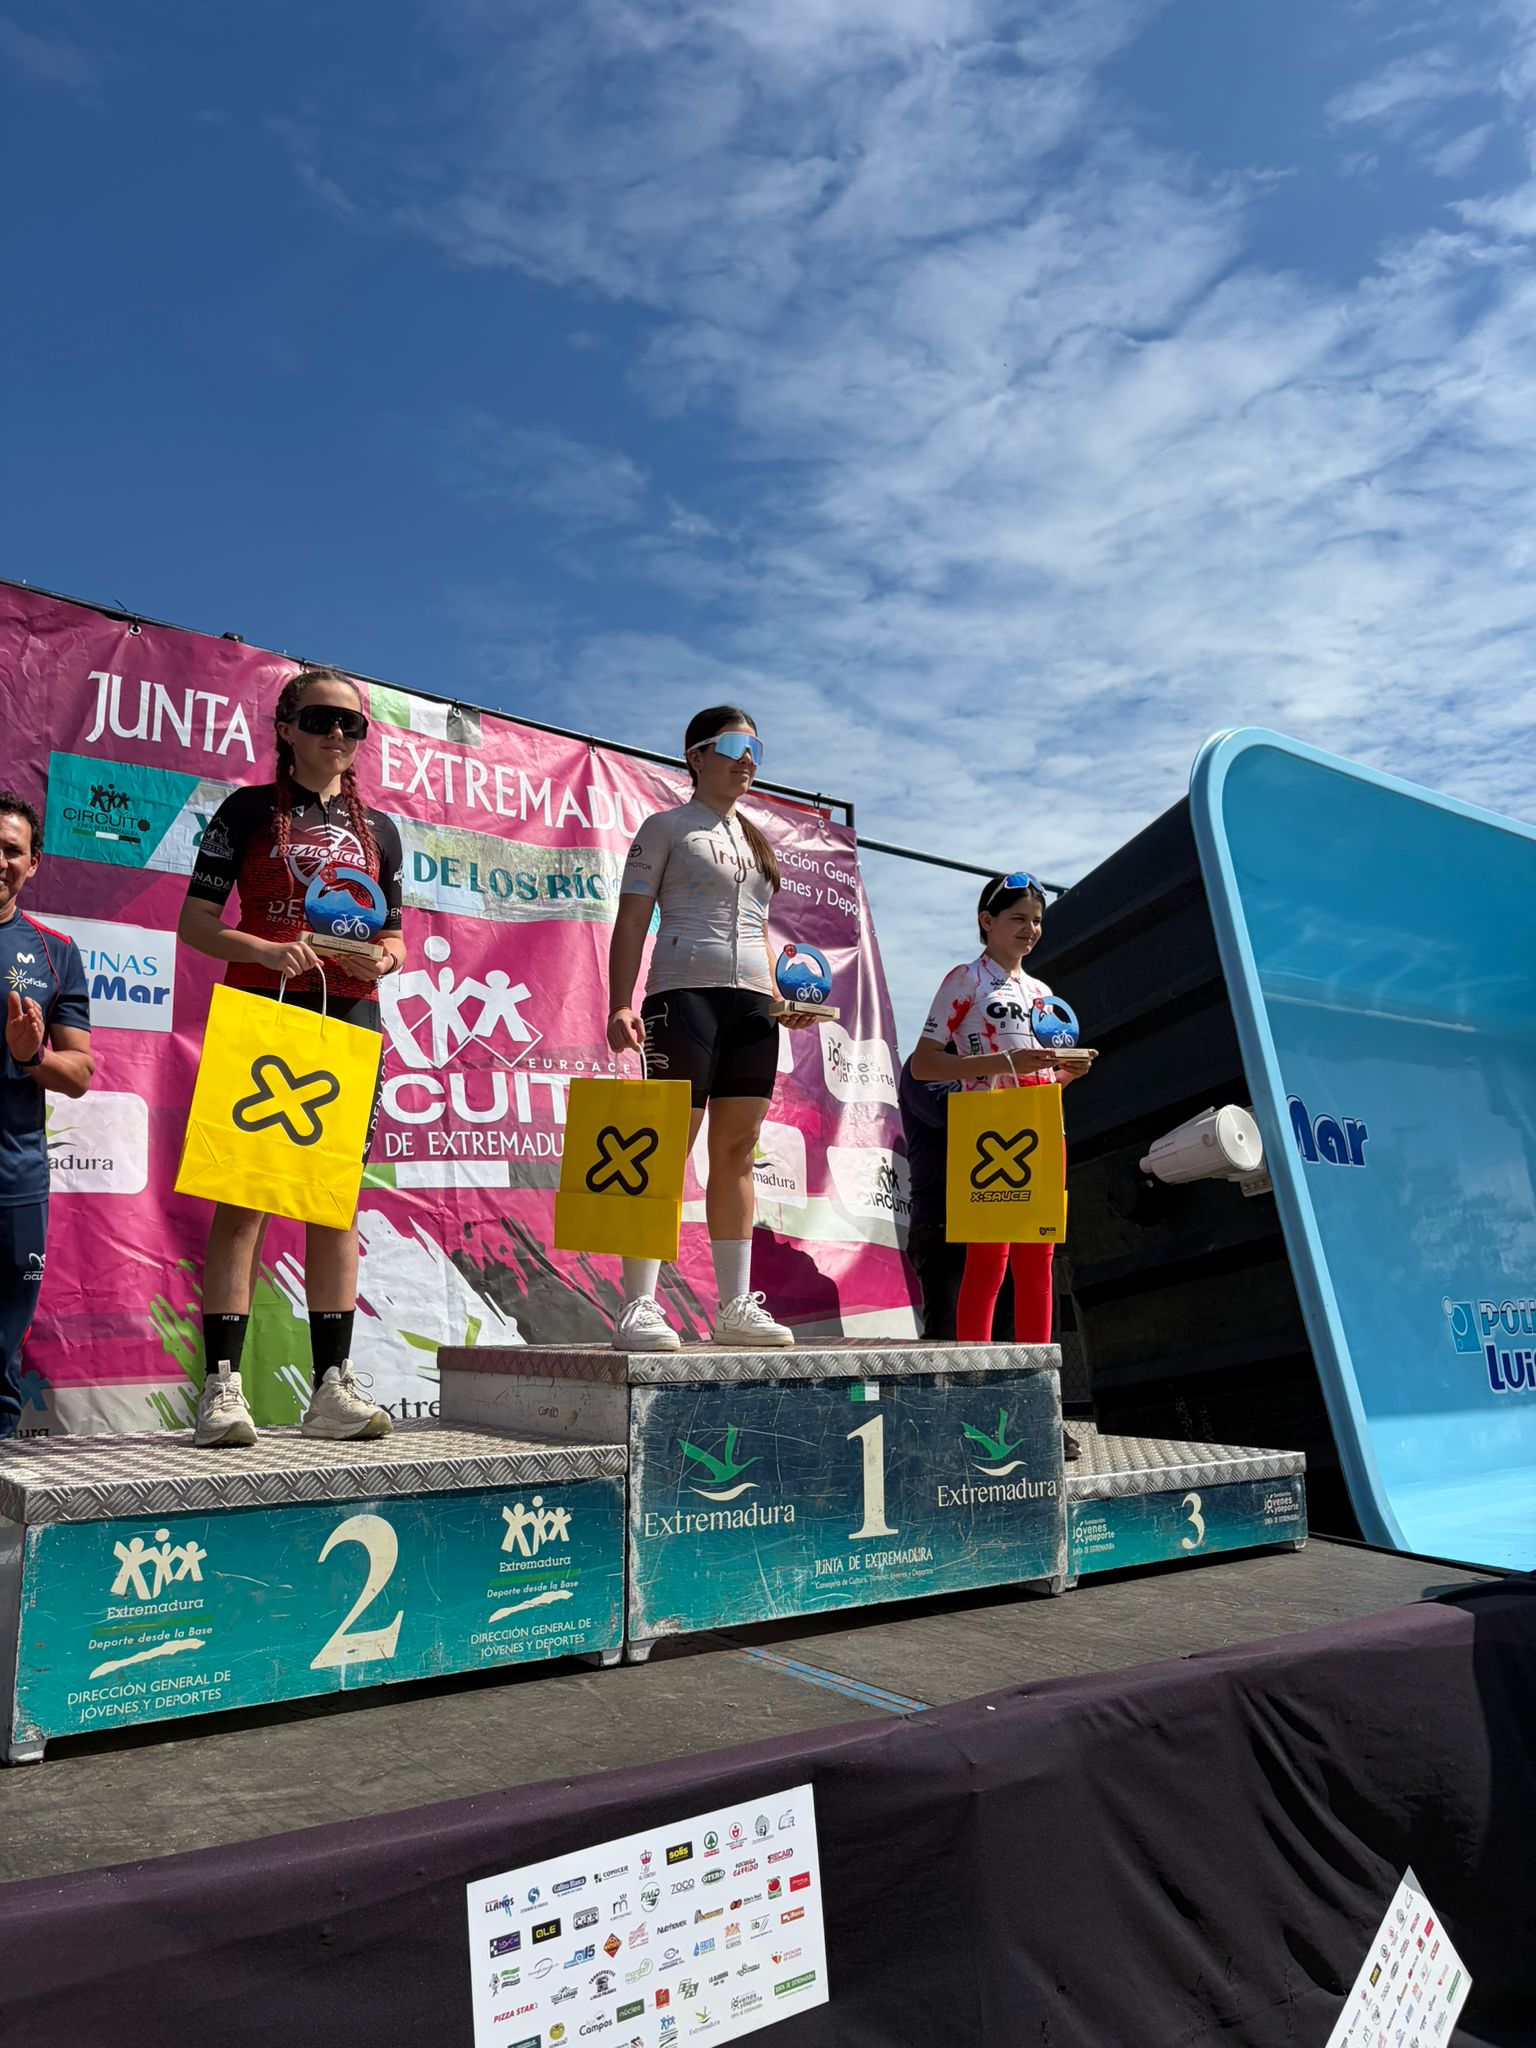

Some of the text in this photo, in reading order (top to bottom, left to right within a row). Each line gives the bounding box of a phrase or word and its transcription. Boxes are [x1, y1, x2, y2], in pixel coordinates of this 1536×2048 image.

[85, 671, 256, 764] JUNTA
[413, 850, 463, 889] DE
[470, 861, 540, 901] LOS
[774, 849, 857, 889] ección Gene
[268, 899, 306, 919] DE
[780, 877, 859, 917] enes y Depo
[15, 974, 48, 989] Cofidis
[86, 974, 170, 1005] Mar
[528, 1058, 631, 1074] EUROACE
[382, 1072, 576, 1124] CUIT
[385, 1130, 564, 1158] DE EXTREMADU
[49, 1154, 113, 1171] adura
[1484, 1342, 1536, 1394] Lui
[375, 1397, 440, 1419] xtre
[846, 1413, 899, 1540] 1
[937, 1477, 1057, 1508] Extremadura
[643, 1501, 795, 1538] Extremadura
[1072, 1521, 1107, 1540] jóvenes
[1181, 1491, 1205, 1550] 3
[499, 1556, 571, 1573] Extremadura
[815, 1546, 934, 1578] JUNTA DE EXTREMADURA
[310, 1513, 404, 1671] 2
[487, 1580, 579, 1599] Deporte desde la Base
[107, 1598, 204, 1620] Extremadura
[88, 1626, 213, 1650] Deporte desde la Base
[470, 1618, 592, 1645] DIRECCIÓN GENERAL DE
[481, 1633, 585, 1659] JÓVENES Y DEPORTES
[67, 1670, 232, 1705] DIRECCIÓN GENERAL DE
[80, 1688, 222, 1724] JÓVENES Y DEPORTES
[670, 1878, 695, 1895] ZOCO
[702, 1869, 725, 1884] OTERO
[485, 1896, 514, 1913] LLANOS
[493, 2003, 534, 2024] PIZZA STAR
[579, 2019, 613, 2037] Campos
[689, 2020, 720, 2036] Extremadura
